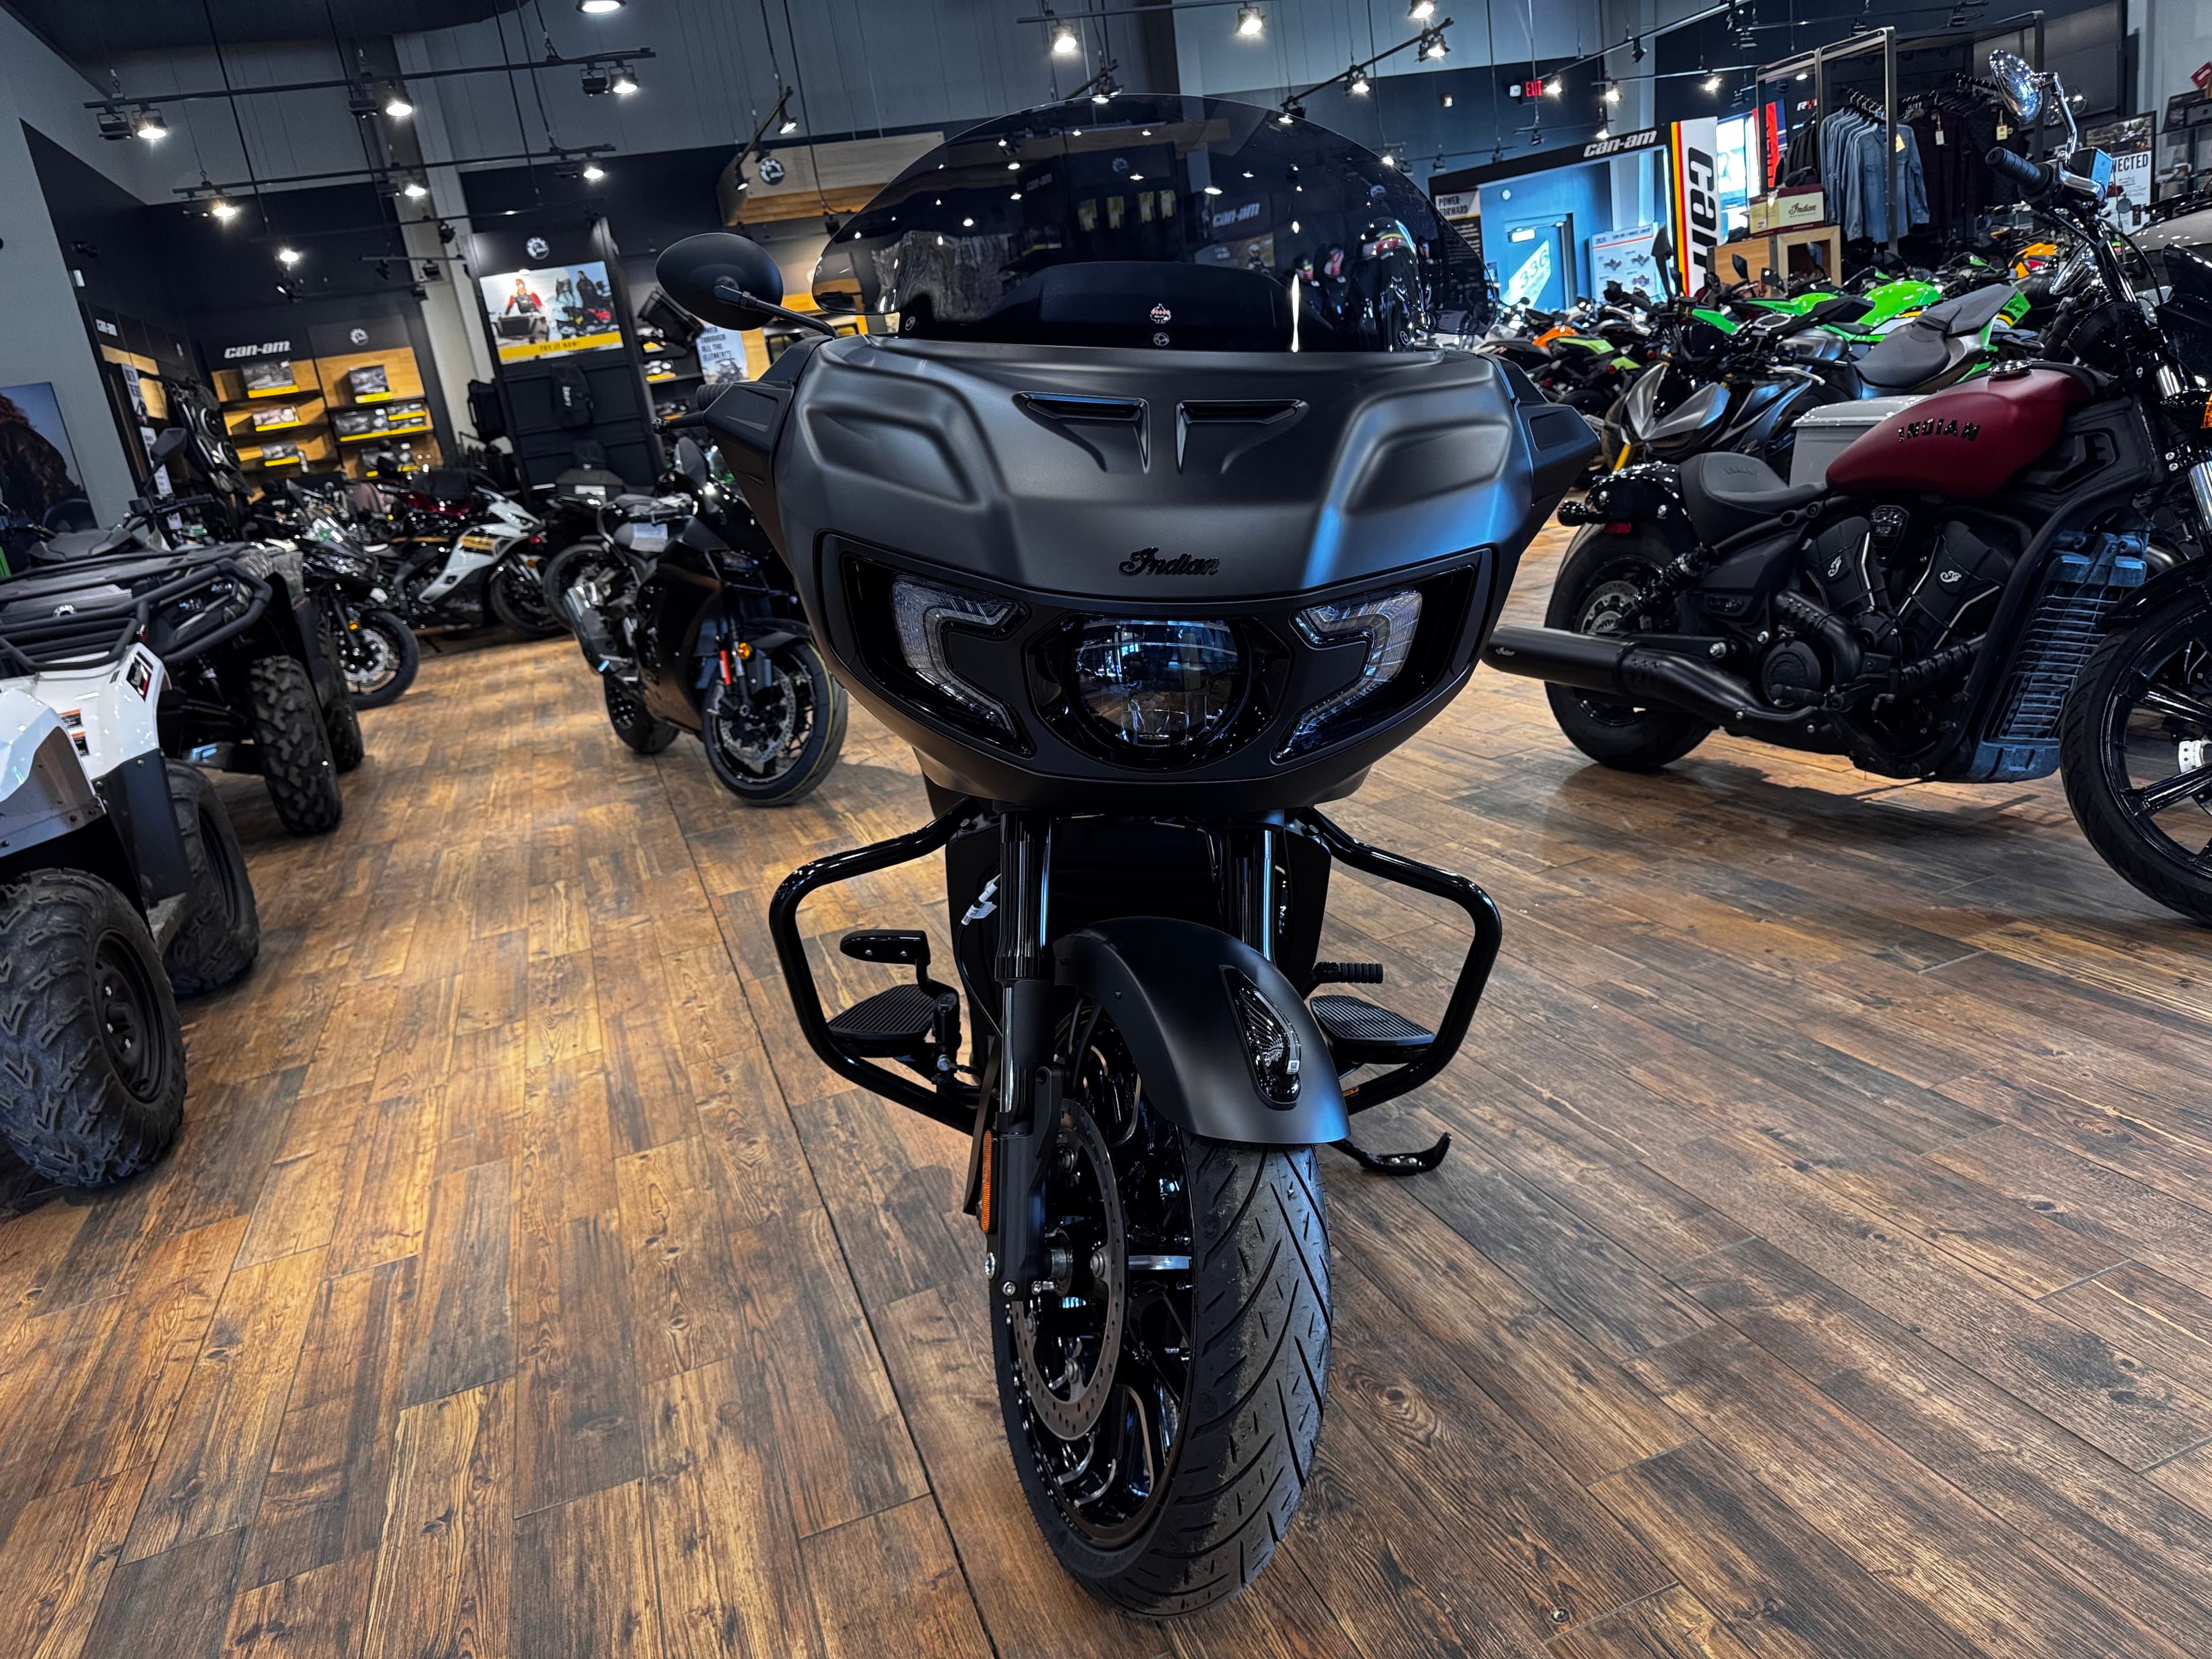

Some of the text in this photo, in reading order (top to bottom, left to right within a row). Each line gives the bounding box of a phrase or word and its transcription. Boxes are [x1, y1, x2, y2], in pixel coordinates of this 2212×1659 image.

[1525, 81, 1543, 97] EXIT
[1583, 130, 1657, 158] can-am
[224, 340, 290, 359] can-am
[1898, 418, 1981, 442] INDIAN
[1119, 547, 1220, 575] Indian
